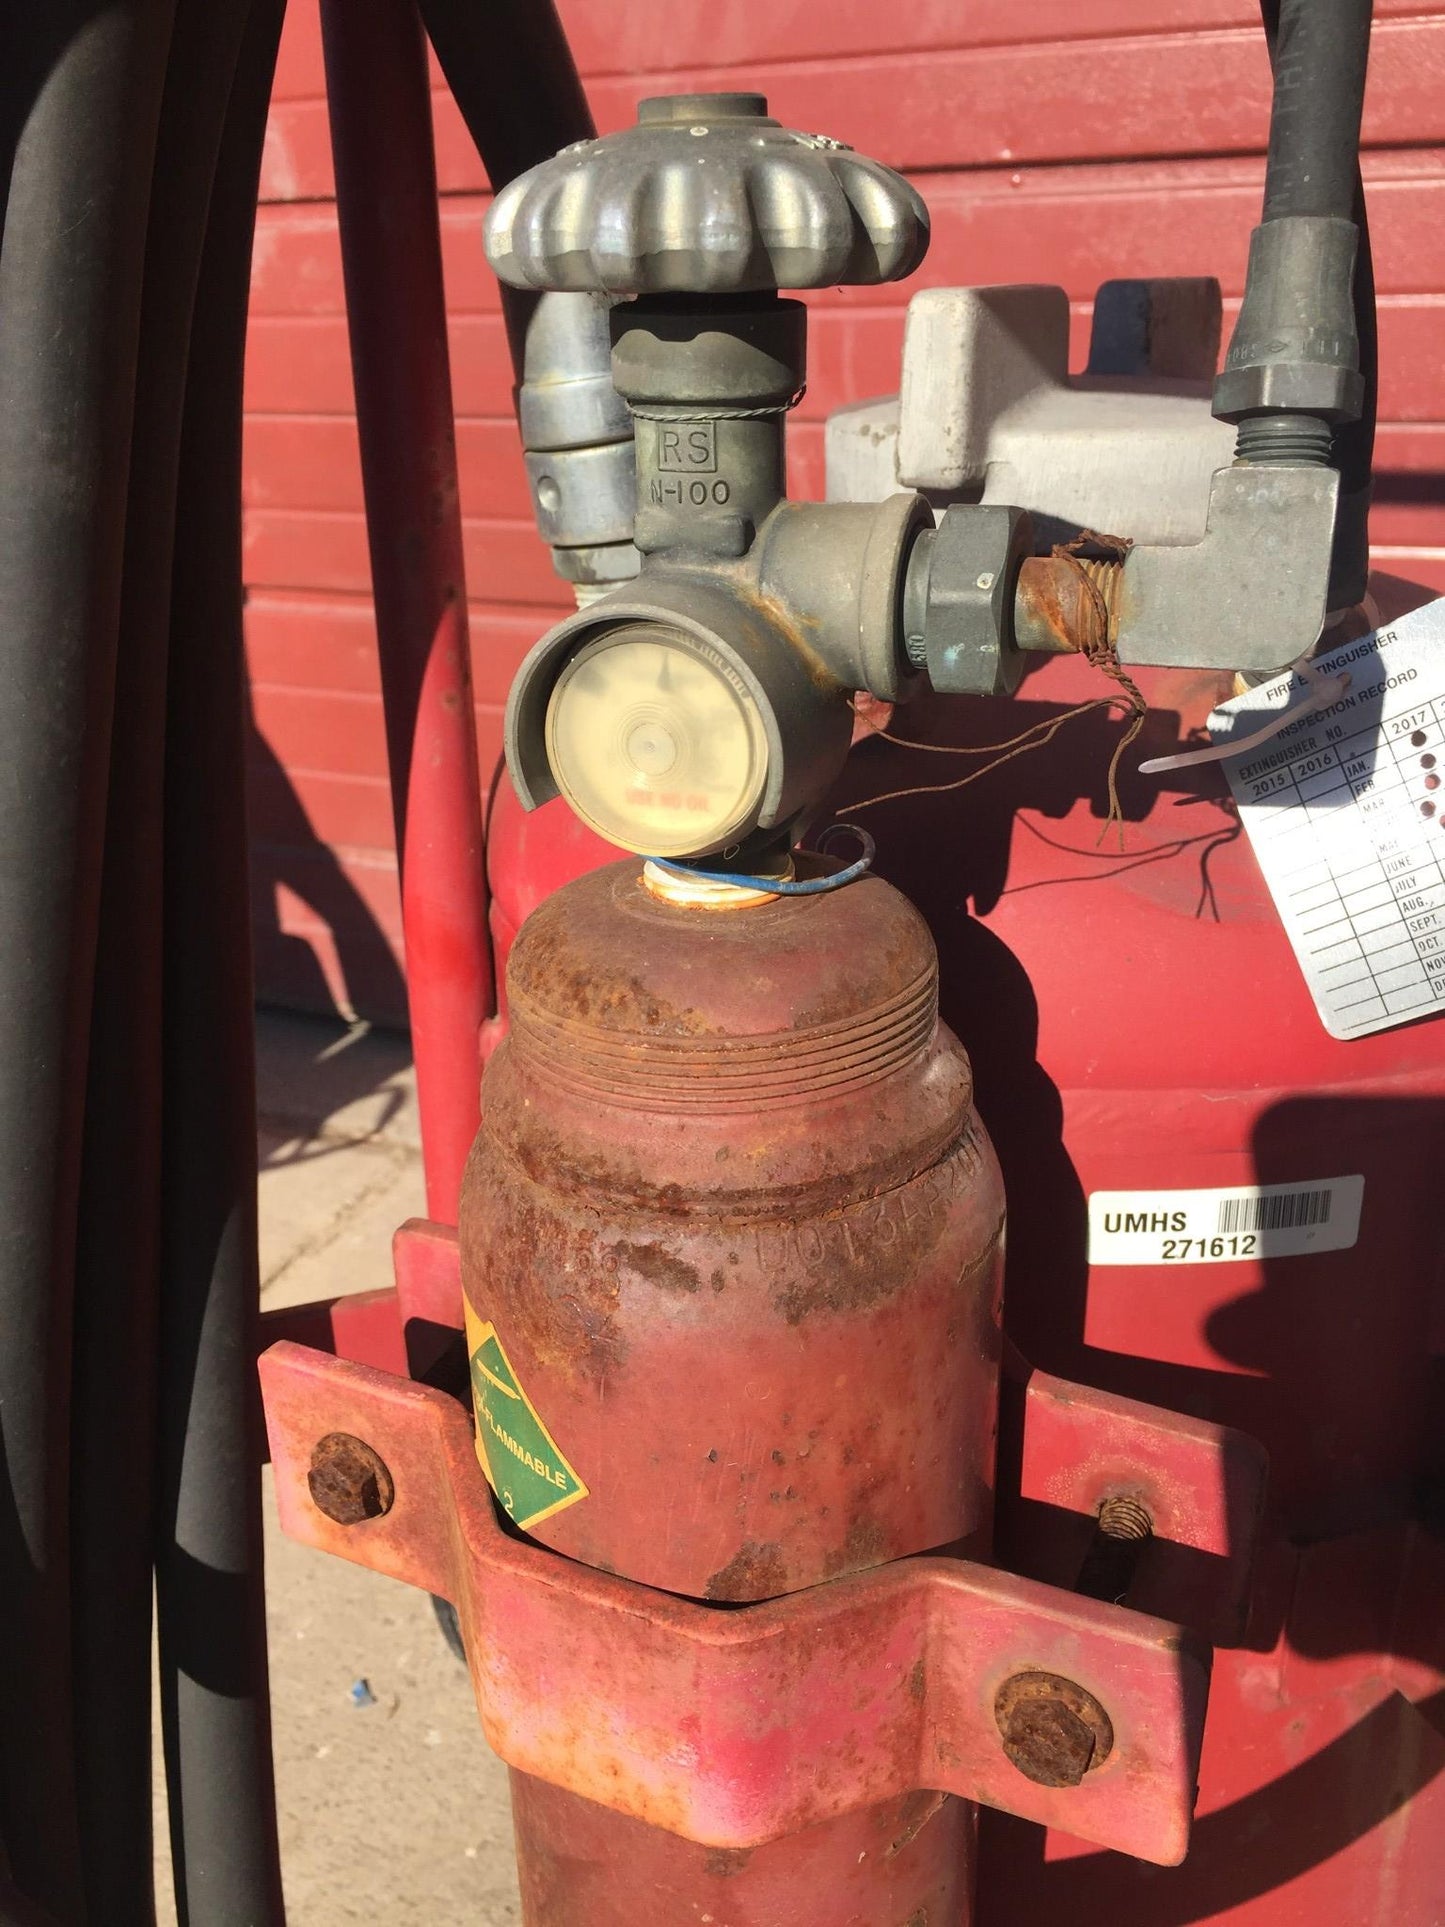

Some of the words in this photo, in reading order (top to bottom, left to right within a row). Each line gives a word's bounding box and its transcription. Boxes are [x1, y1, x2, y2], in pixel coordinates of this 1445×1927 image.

[663, 431, 709, 464] RS
[651, 479, 730, 505] N-100
[1266, 679, 1296, 701] FIRE
[1299, 631, 1399, 686] ETINGUISHER
[1277, 697, 1357, 740] INSPECTION
[1358, 668, 1418, 702] RECORD
[1239, 737, 1318, 780] EXTINGUISHER
[1326, 725, 1347, 742] NO.
[1253, 774, 1285, 796] 2015
[1299, 754, 1333, 776] 2016
[1392, 711, 1426, 734] 2017
[1347, 761, 1371, 777] JAN.
[1386, 855, 1412, 874] JUNE
[1395, 875, 1417, 894] JULY
[1410, 914, 1442, 932] SEPT.
[1418, 936, 1443, 952] OCT.
[1104, 1212, 1187, 1233] UMHS
[1161, 1235, 1257, 1260] 271612
